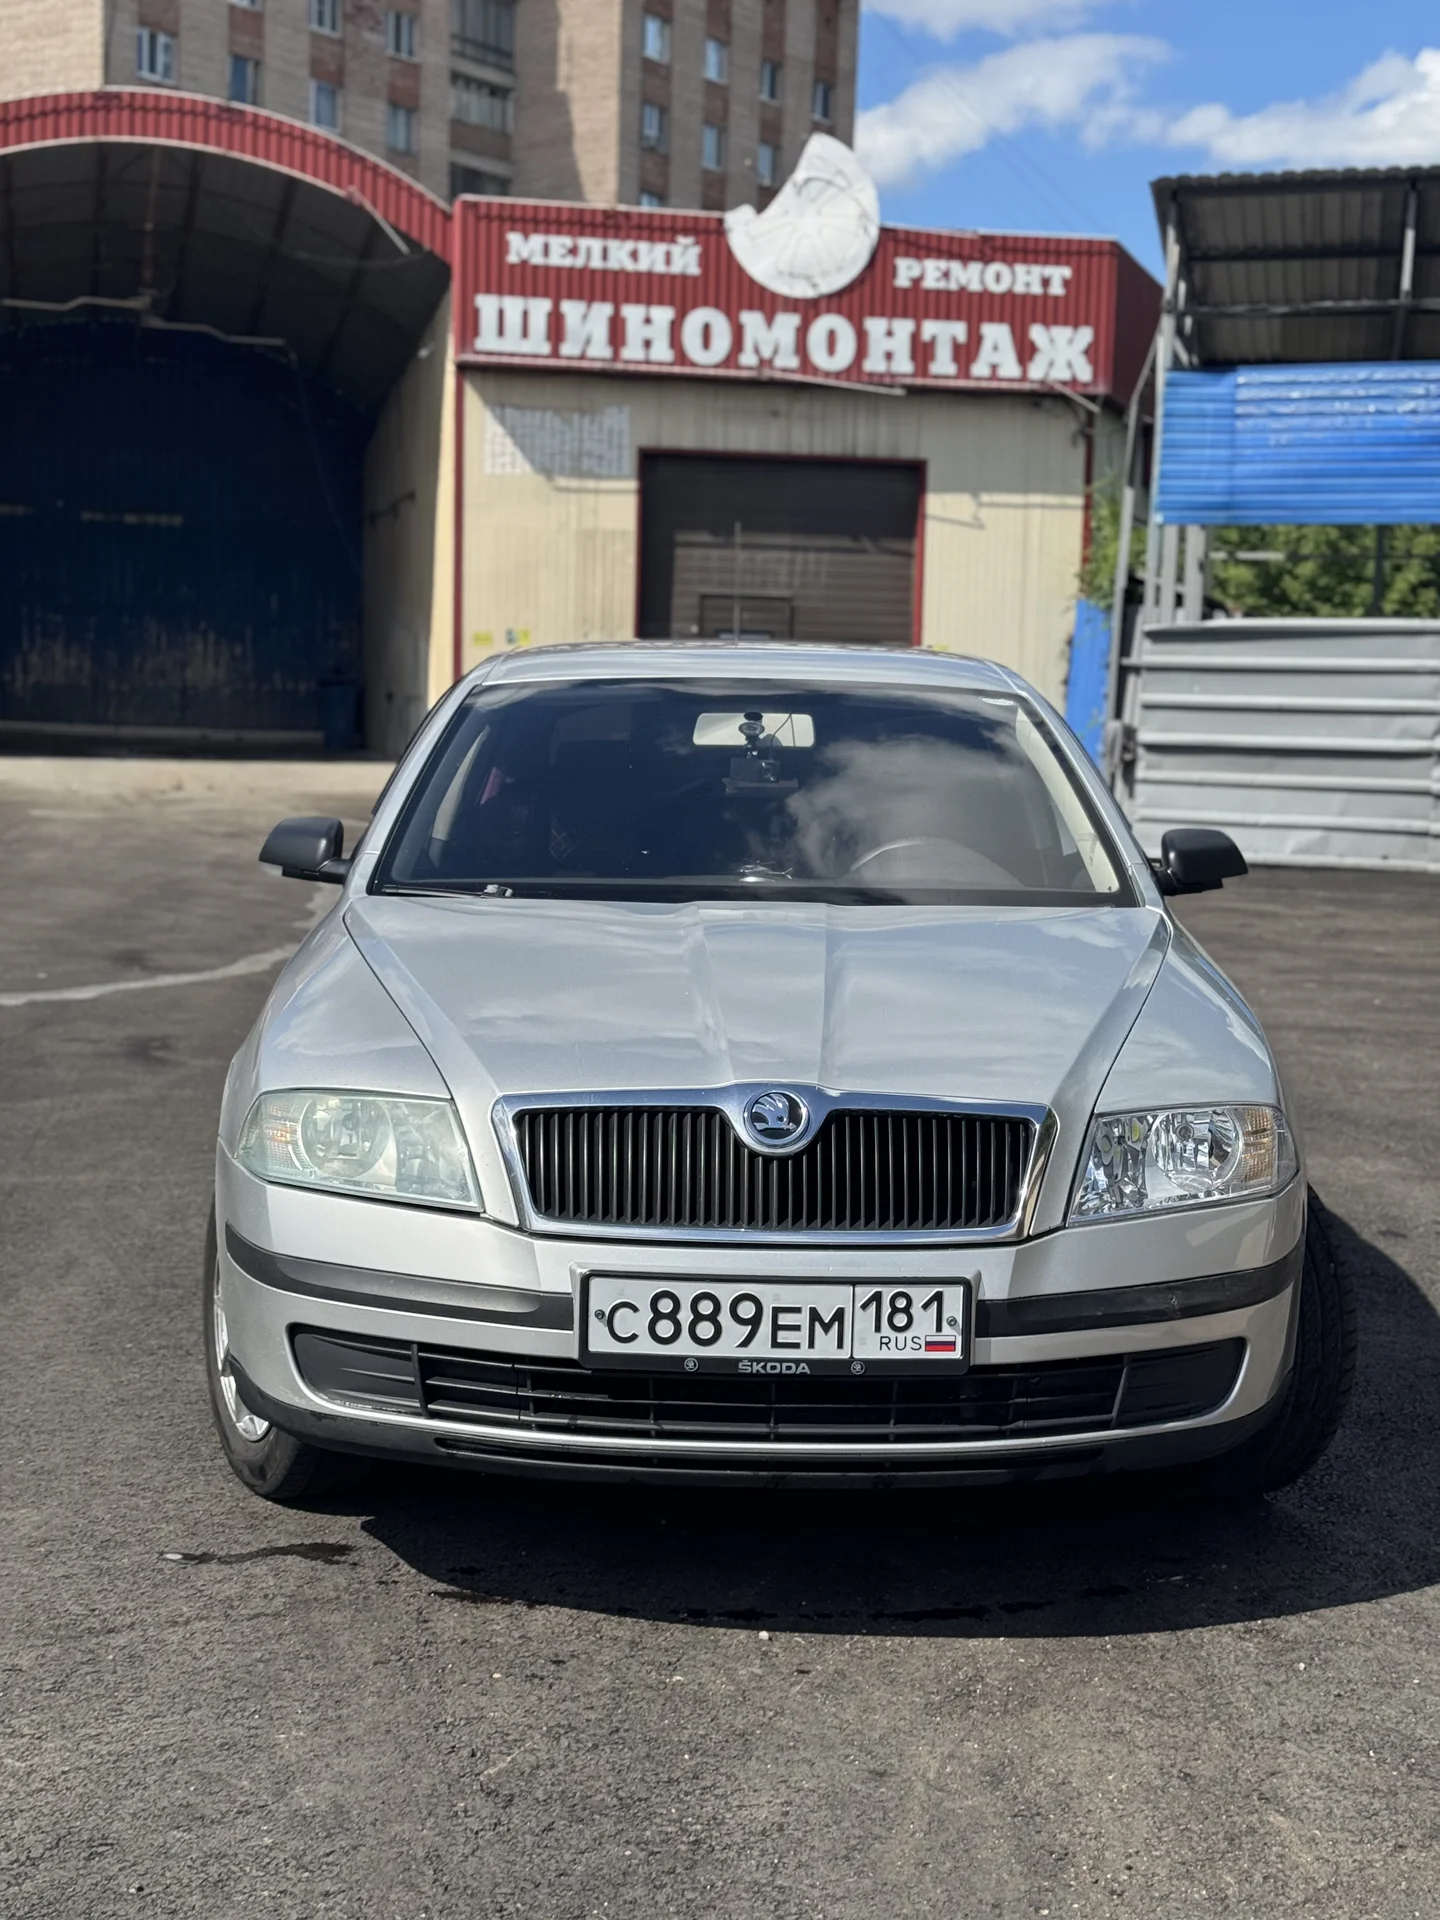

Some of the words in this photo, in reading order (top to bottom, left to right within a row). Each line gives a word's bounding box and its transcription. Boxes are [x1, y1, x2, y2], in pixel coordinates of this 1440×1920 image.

[506, 231, 701, 276] МЕЛКИЙ
[893, 257, 1072, 296] РЕМОНТ
[474, 293, 1095, 383] ШИНОМОНТАЖ
[858, 1290, 944, 1333] 181
[879, 1336, 922, 1352] RUS
[737, 1359, 811, 1375] ŠKODA
